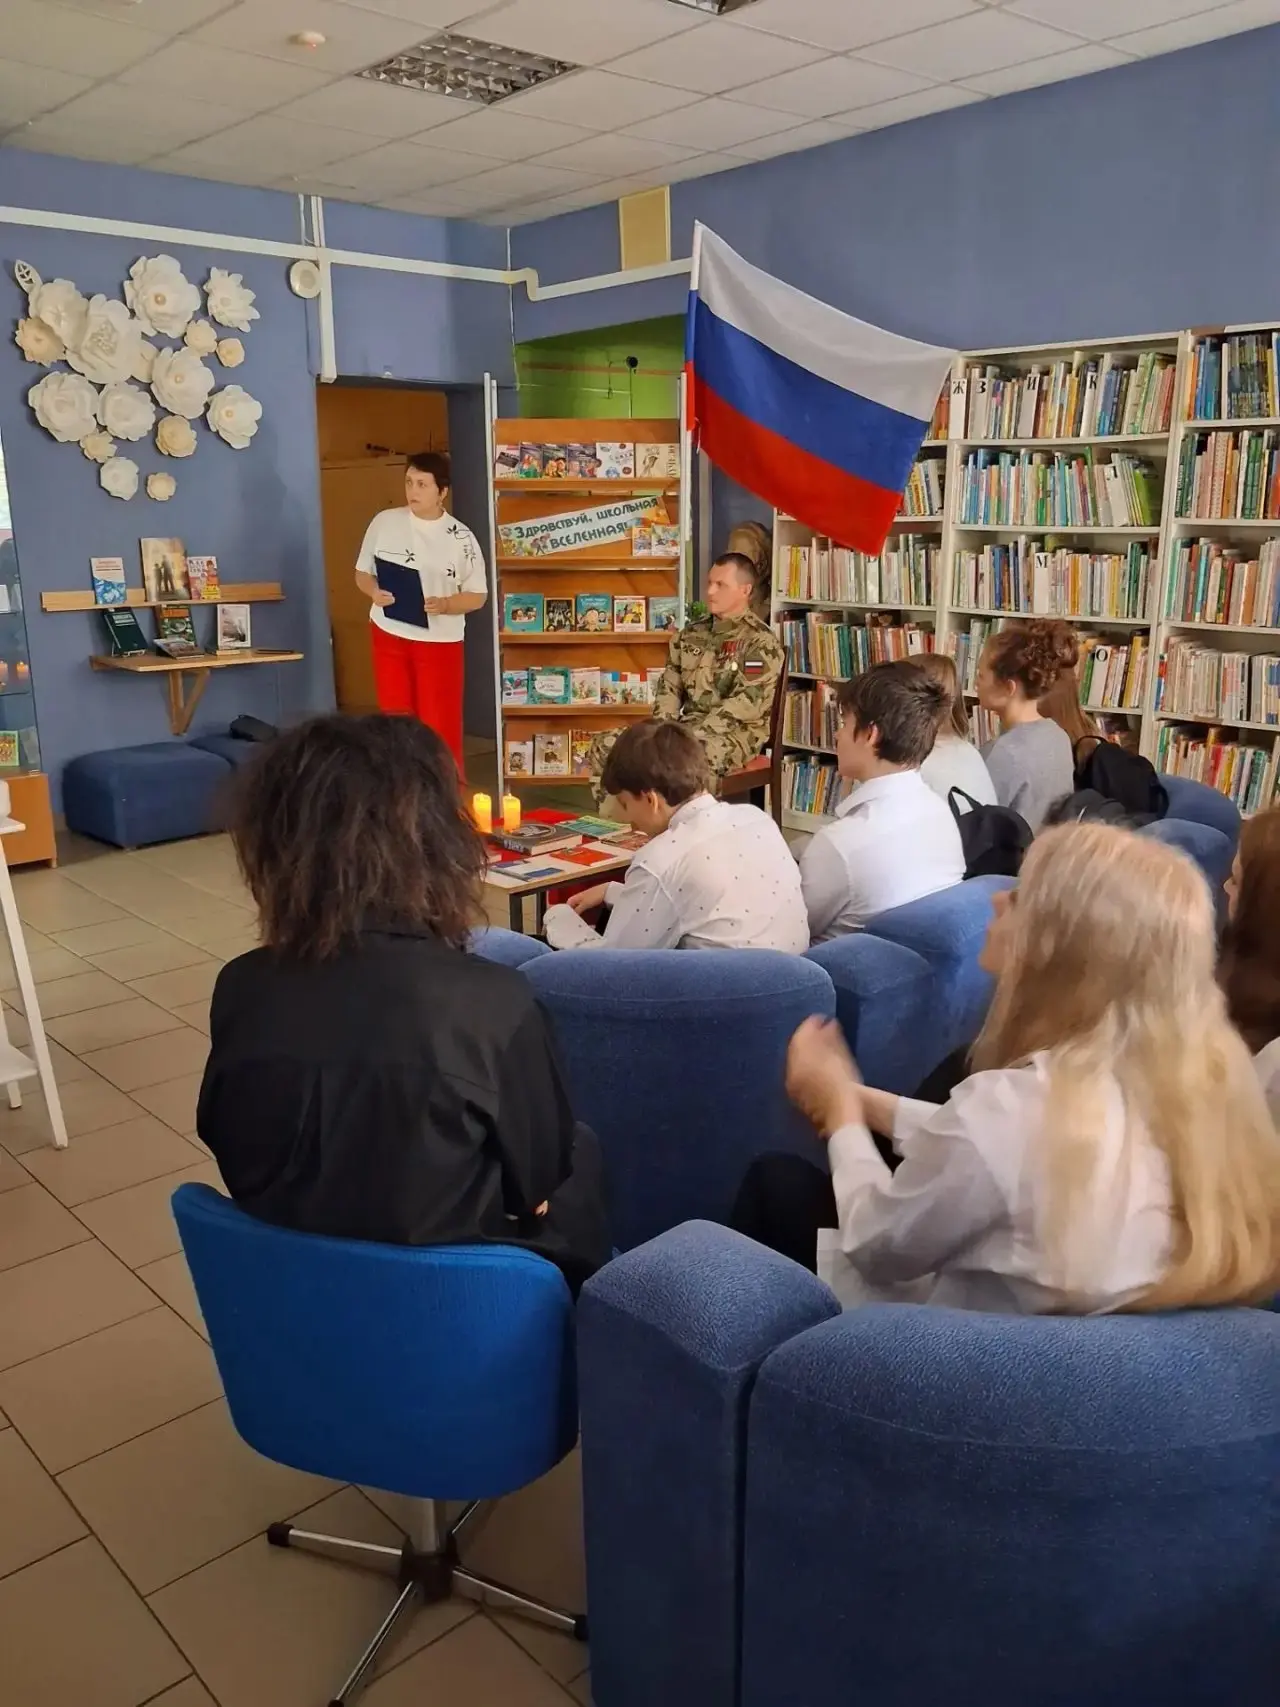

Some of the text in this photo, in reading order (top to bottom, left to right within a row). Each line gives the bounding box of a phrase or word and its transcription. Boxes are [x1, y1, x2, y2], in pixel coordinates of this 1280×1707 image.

[952, 380, 966, 394] Ж
[977, 381, 987, 394] З
[1088, 376, 1097, 390] К
[596, 498, 658, 520] ШКОЛЬНАЯ
[1036, 555, 1049, 569] М
[1096, 648, 1108, 662] О
